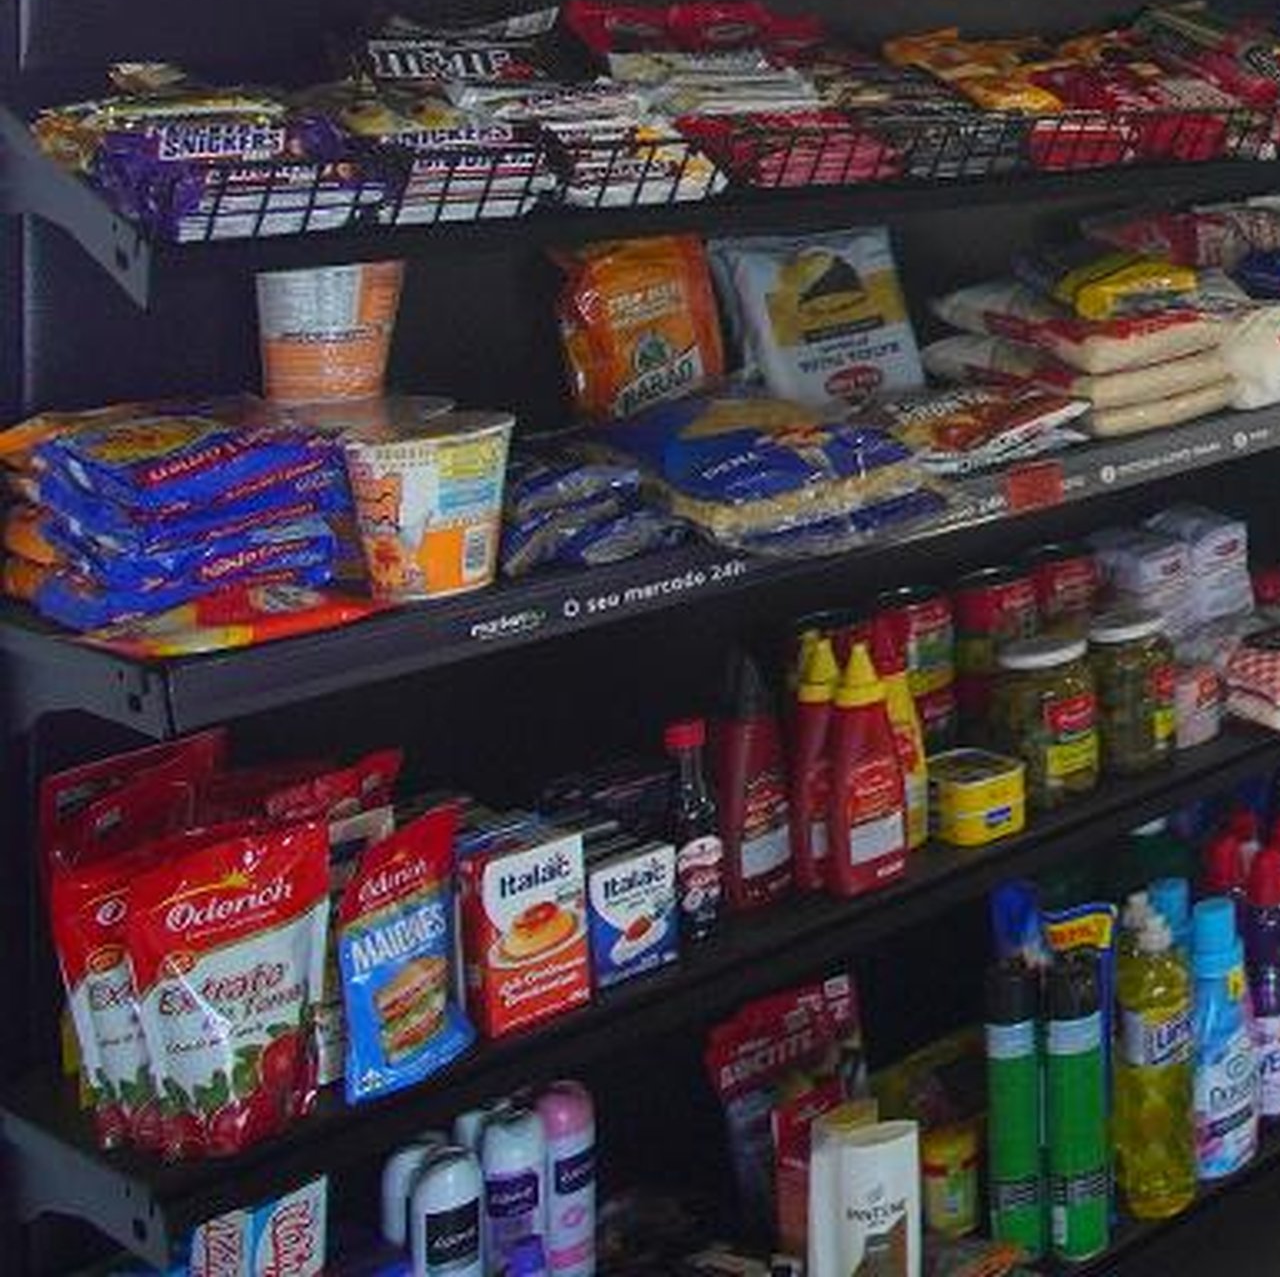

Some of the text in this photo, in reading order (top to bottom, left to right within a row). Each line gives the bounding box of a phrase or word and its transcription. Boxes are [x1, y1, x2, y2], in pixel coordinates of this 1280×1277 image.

[161, 127, 285, 159] SNICKERS
[563, 598, 581, 619] O
[586, 591, 620, 615] seu
[624, 571, 707, 605] mercado
[709, 560, 748, 582] 24h
[498, 849, 572, 900] Italac
[601, 856, 668, 902] Italac
